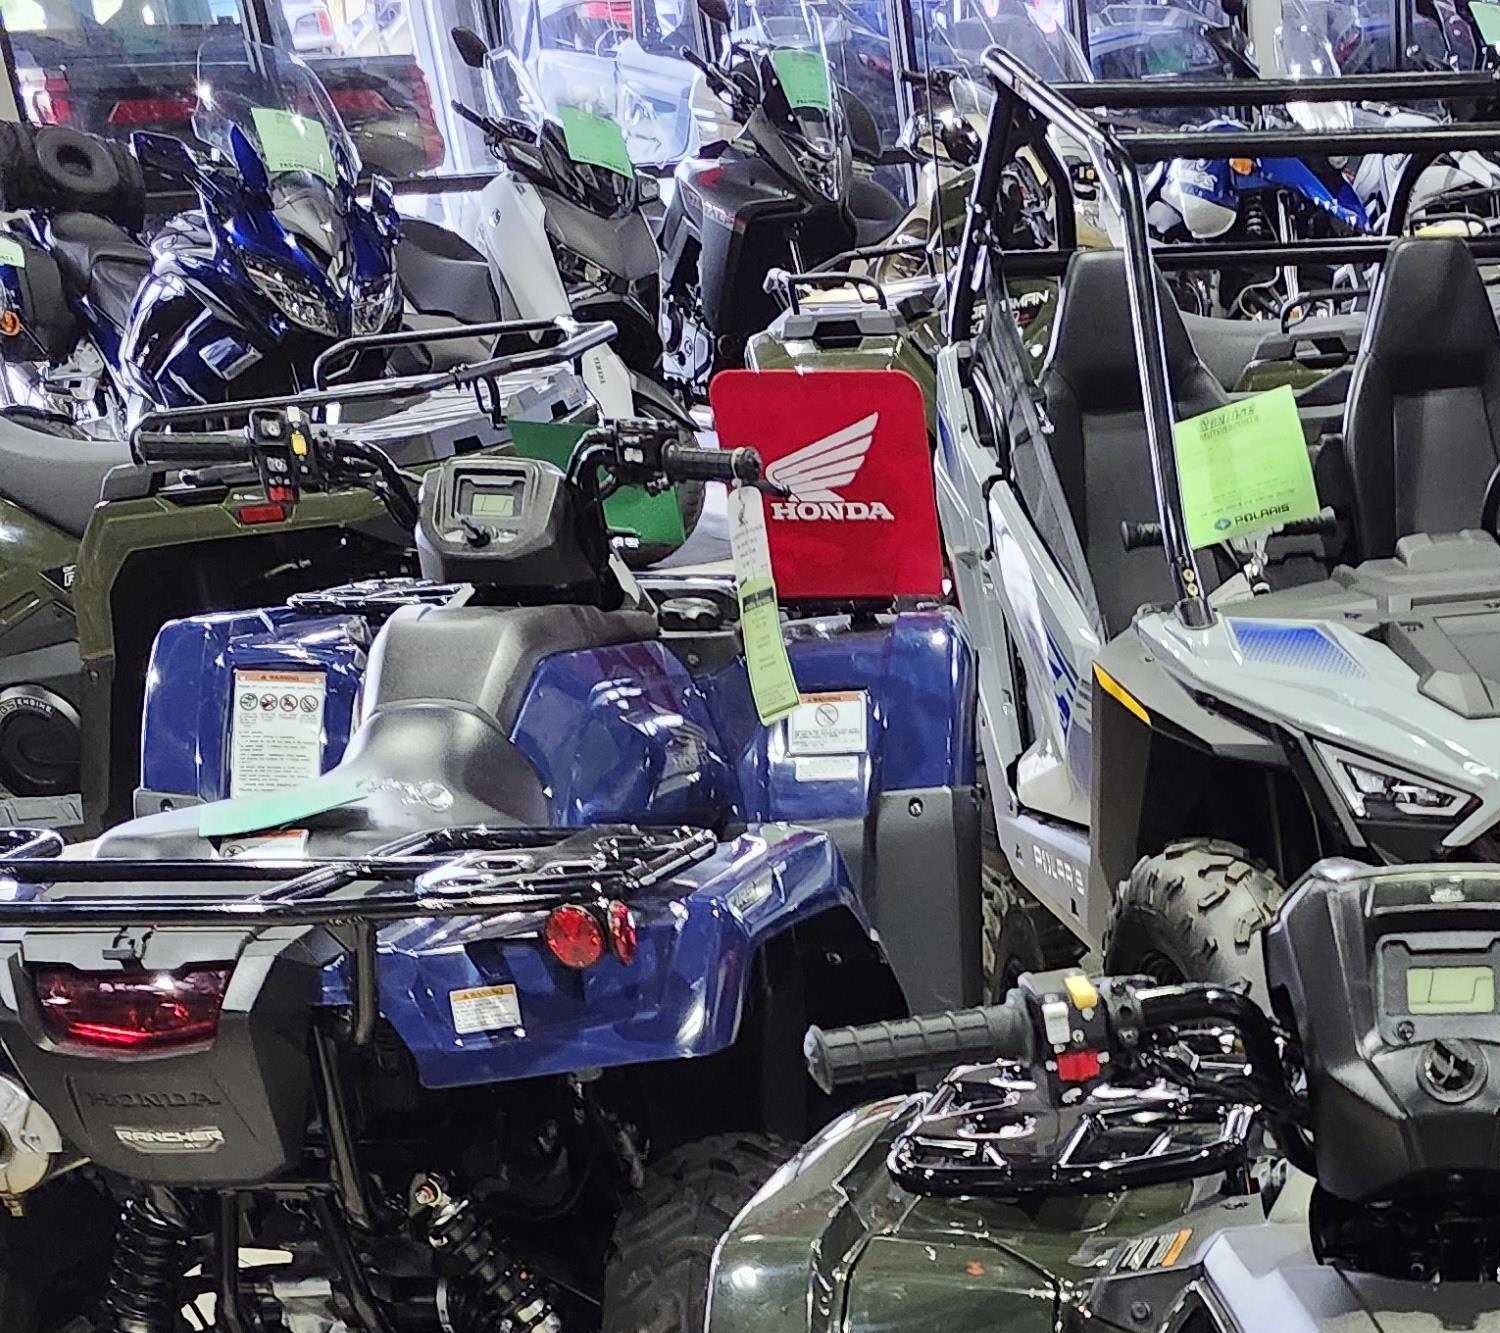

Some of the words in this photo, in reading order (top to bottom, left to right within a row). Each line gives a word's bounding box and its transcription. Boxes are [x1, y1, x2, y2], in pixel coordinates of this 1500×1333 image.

[770, 502, 895, 521] HONDA
[1233, 502, 1291, 528] POLARIS
[87, 1091, 222, 1107] HONDA
[115, 1129, 225, 1143] RANCHER
